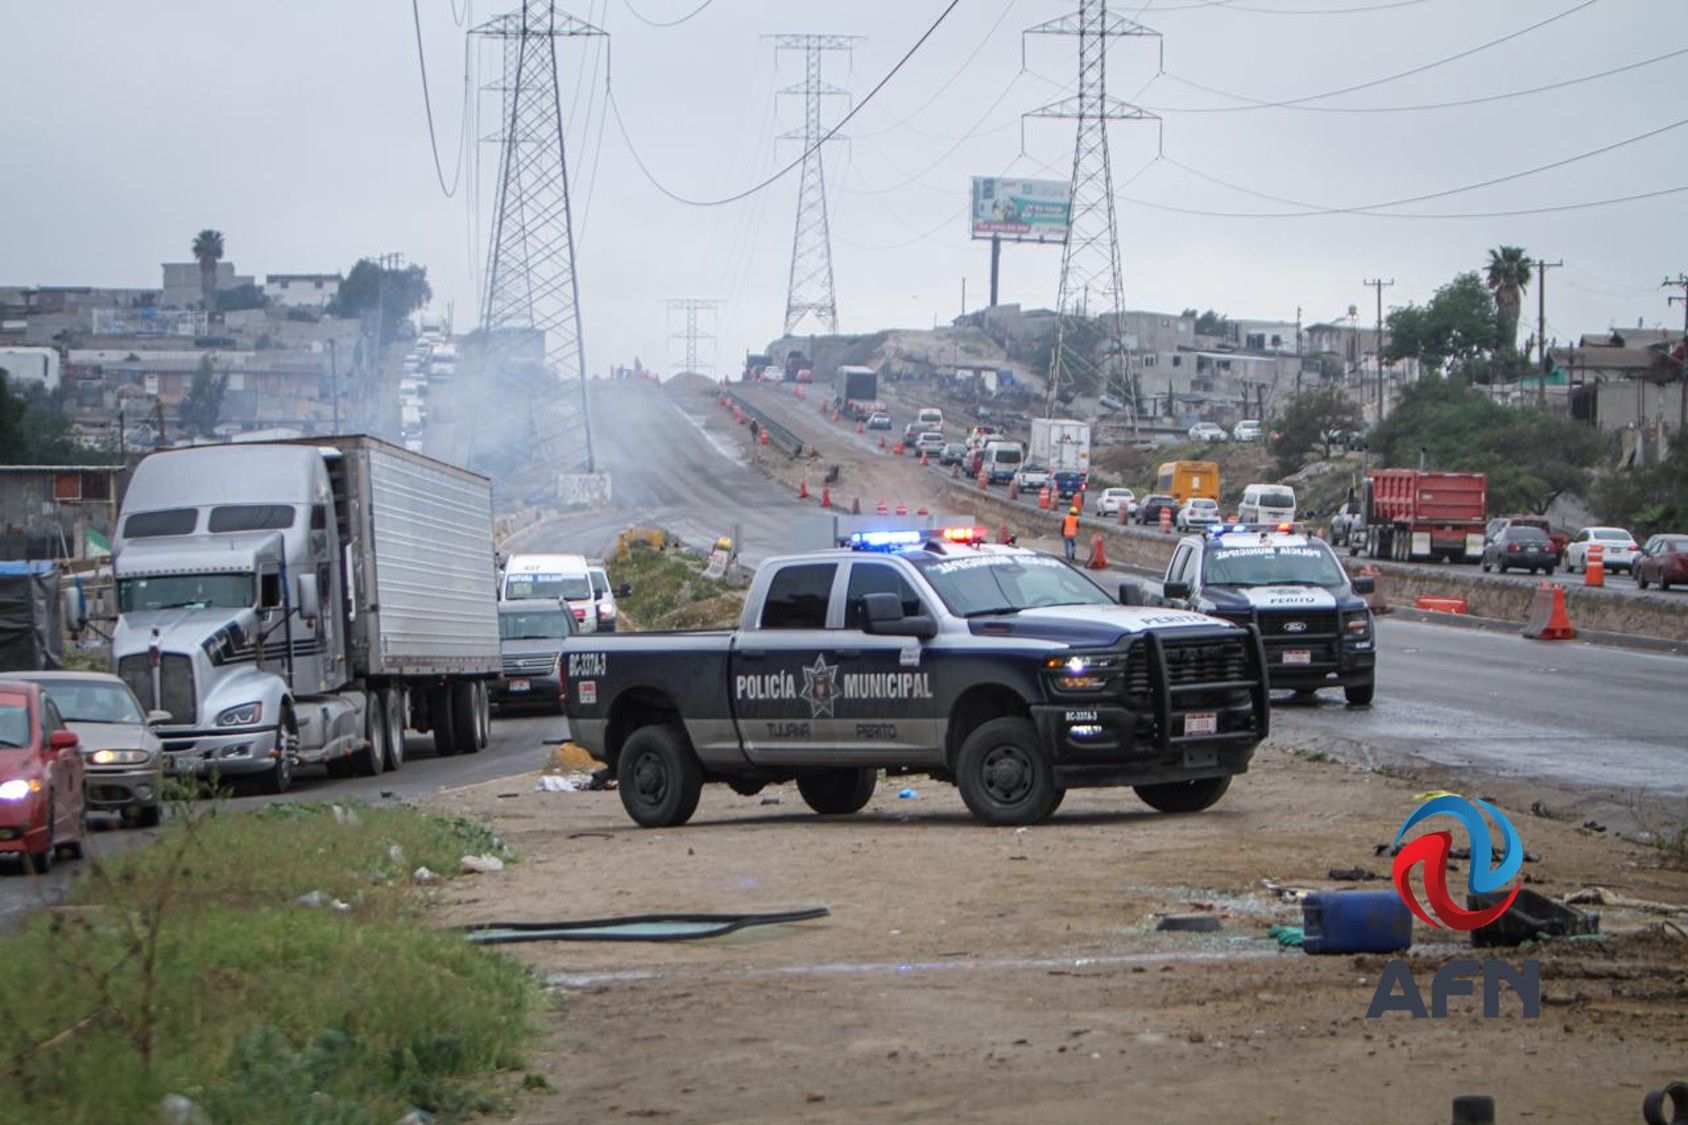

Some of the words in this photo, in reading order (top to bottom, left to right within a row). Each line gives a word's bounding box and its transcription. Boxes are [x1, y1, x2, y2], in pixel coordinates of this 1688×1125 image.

[1140, 615, 1208, 625] PERITO
[569, 653, 607, 677] BC-337A-3
[736, 669, 796, 700] POLICÍA
[844, 672, 933, 699] MUNICIPAL
[856, 722, 898, 739] PERITO
